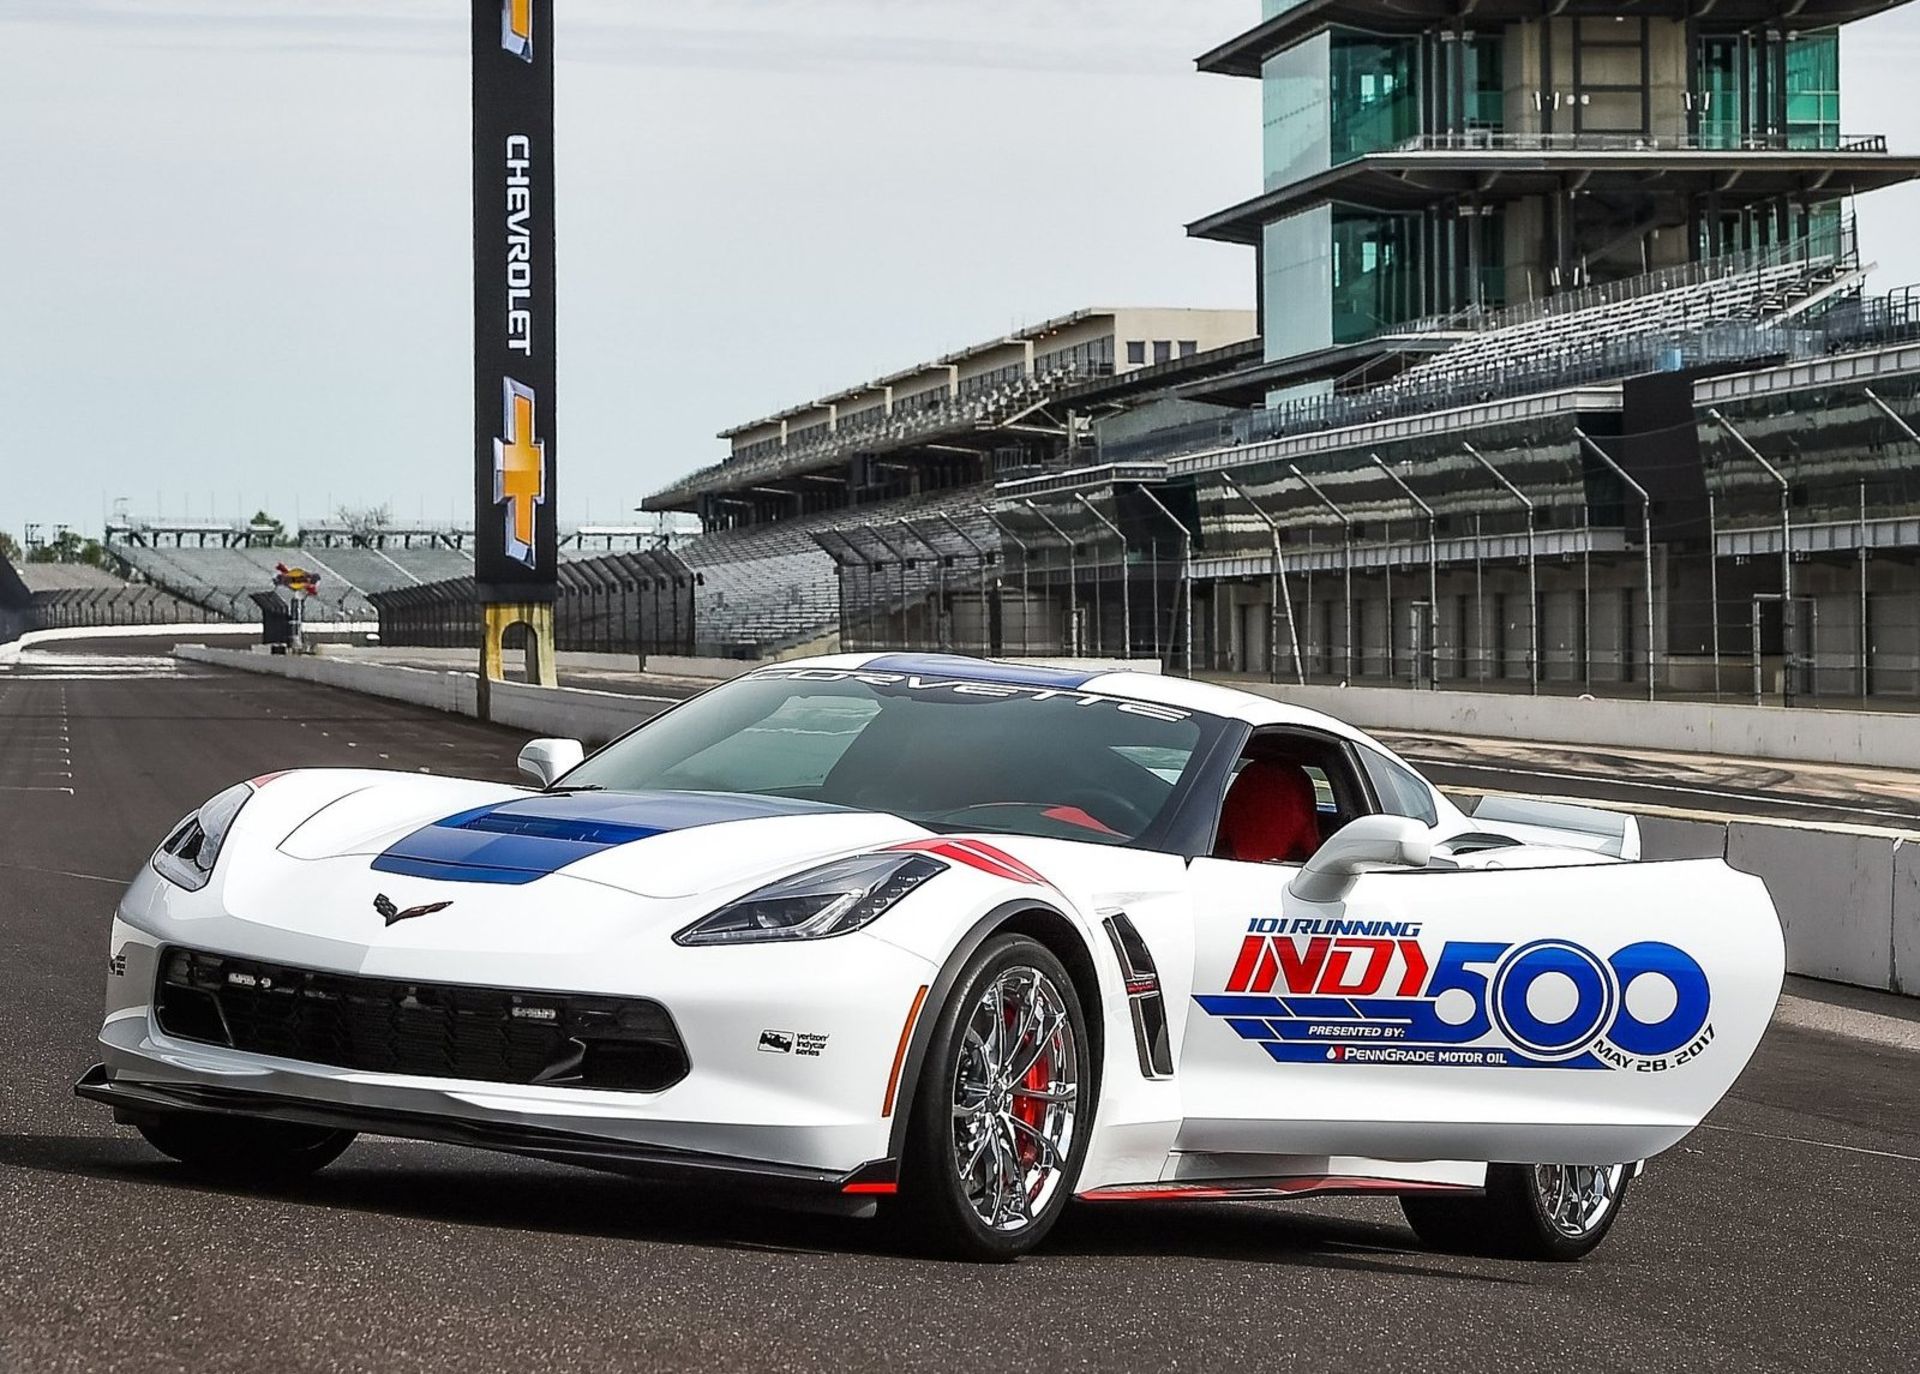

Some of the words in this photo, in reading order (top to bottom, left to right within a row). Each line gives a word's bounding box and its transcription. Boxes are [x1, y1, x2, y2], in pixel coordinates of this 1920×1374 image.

[505, 134, 532, 357] CHEVROLET
[737, 668, 1192, 722] CORVETTE
[1247, 917, 1289, 933] 101
[1290, 918, 1423, 937] RUNNING
[1224, 935, 1429, 997] INDY
[1424, 938, 1711, 1057] 500
[1308, 1025, 1382, 1037] PRESENTED
[1384, 1027, 1405, 1038] BY:
[795, 1048, 820, 1057] series
[796, 1040, 827, 1051] indycar
[1593, 1039, 1634, 1069] MAY
[1438, 1052, 1483, 1063] MOTOR
[1486, 1053, 1508, 1064] OIL
